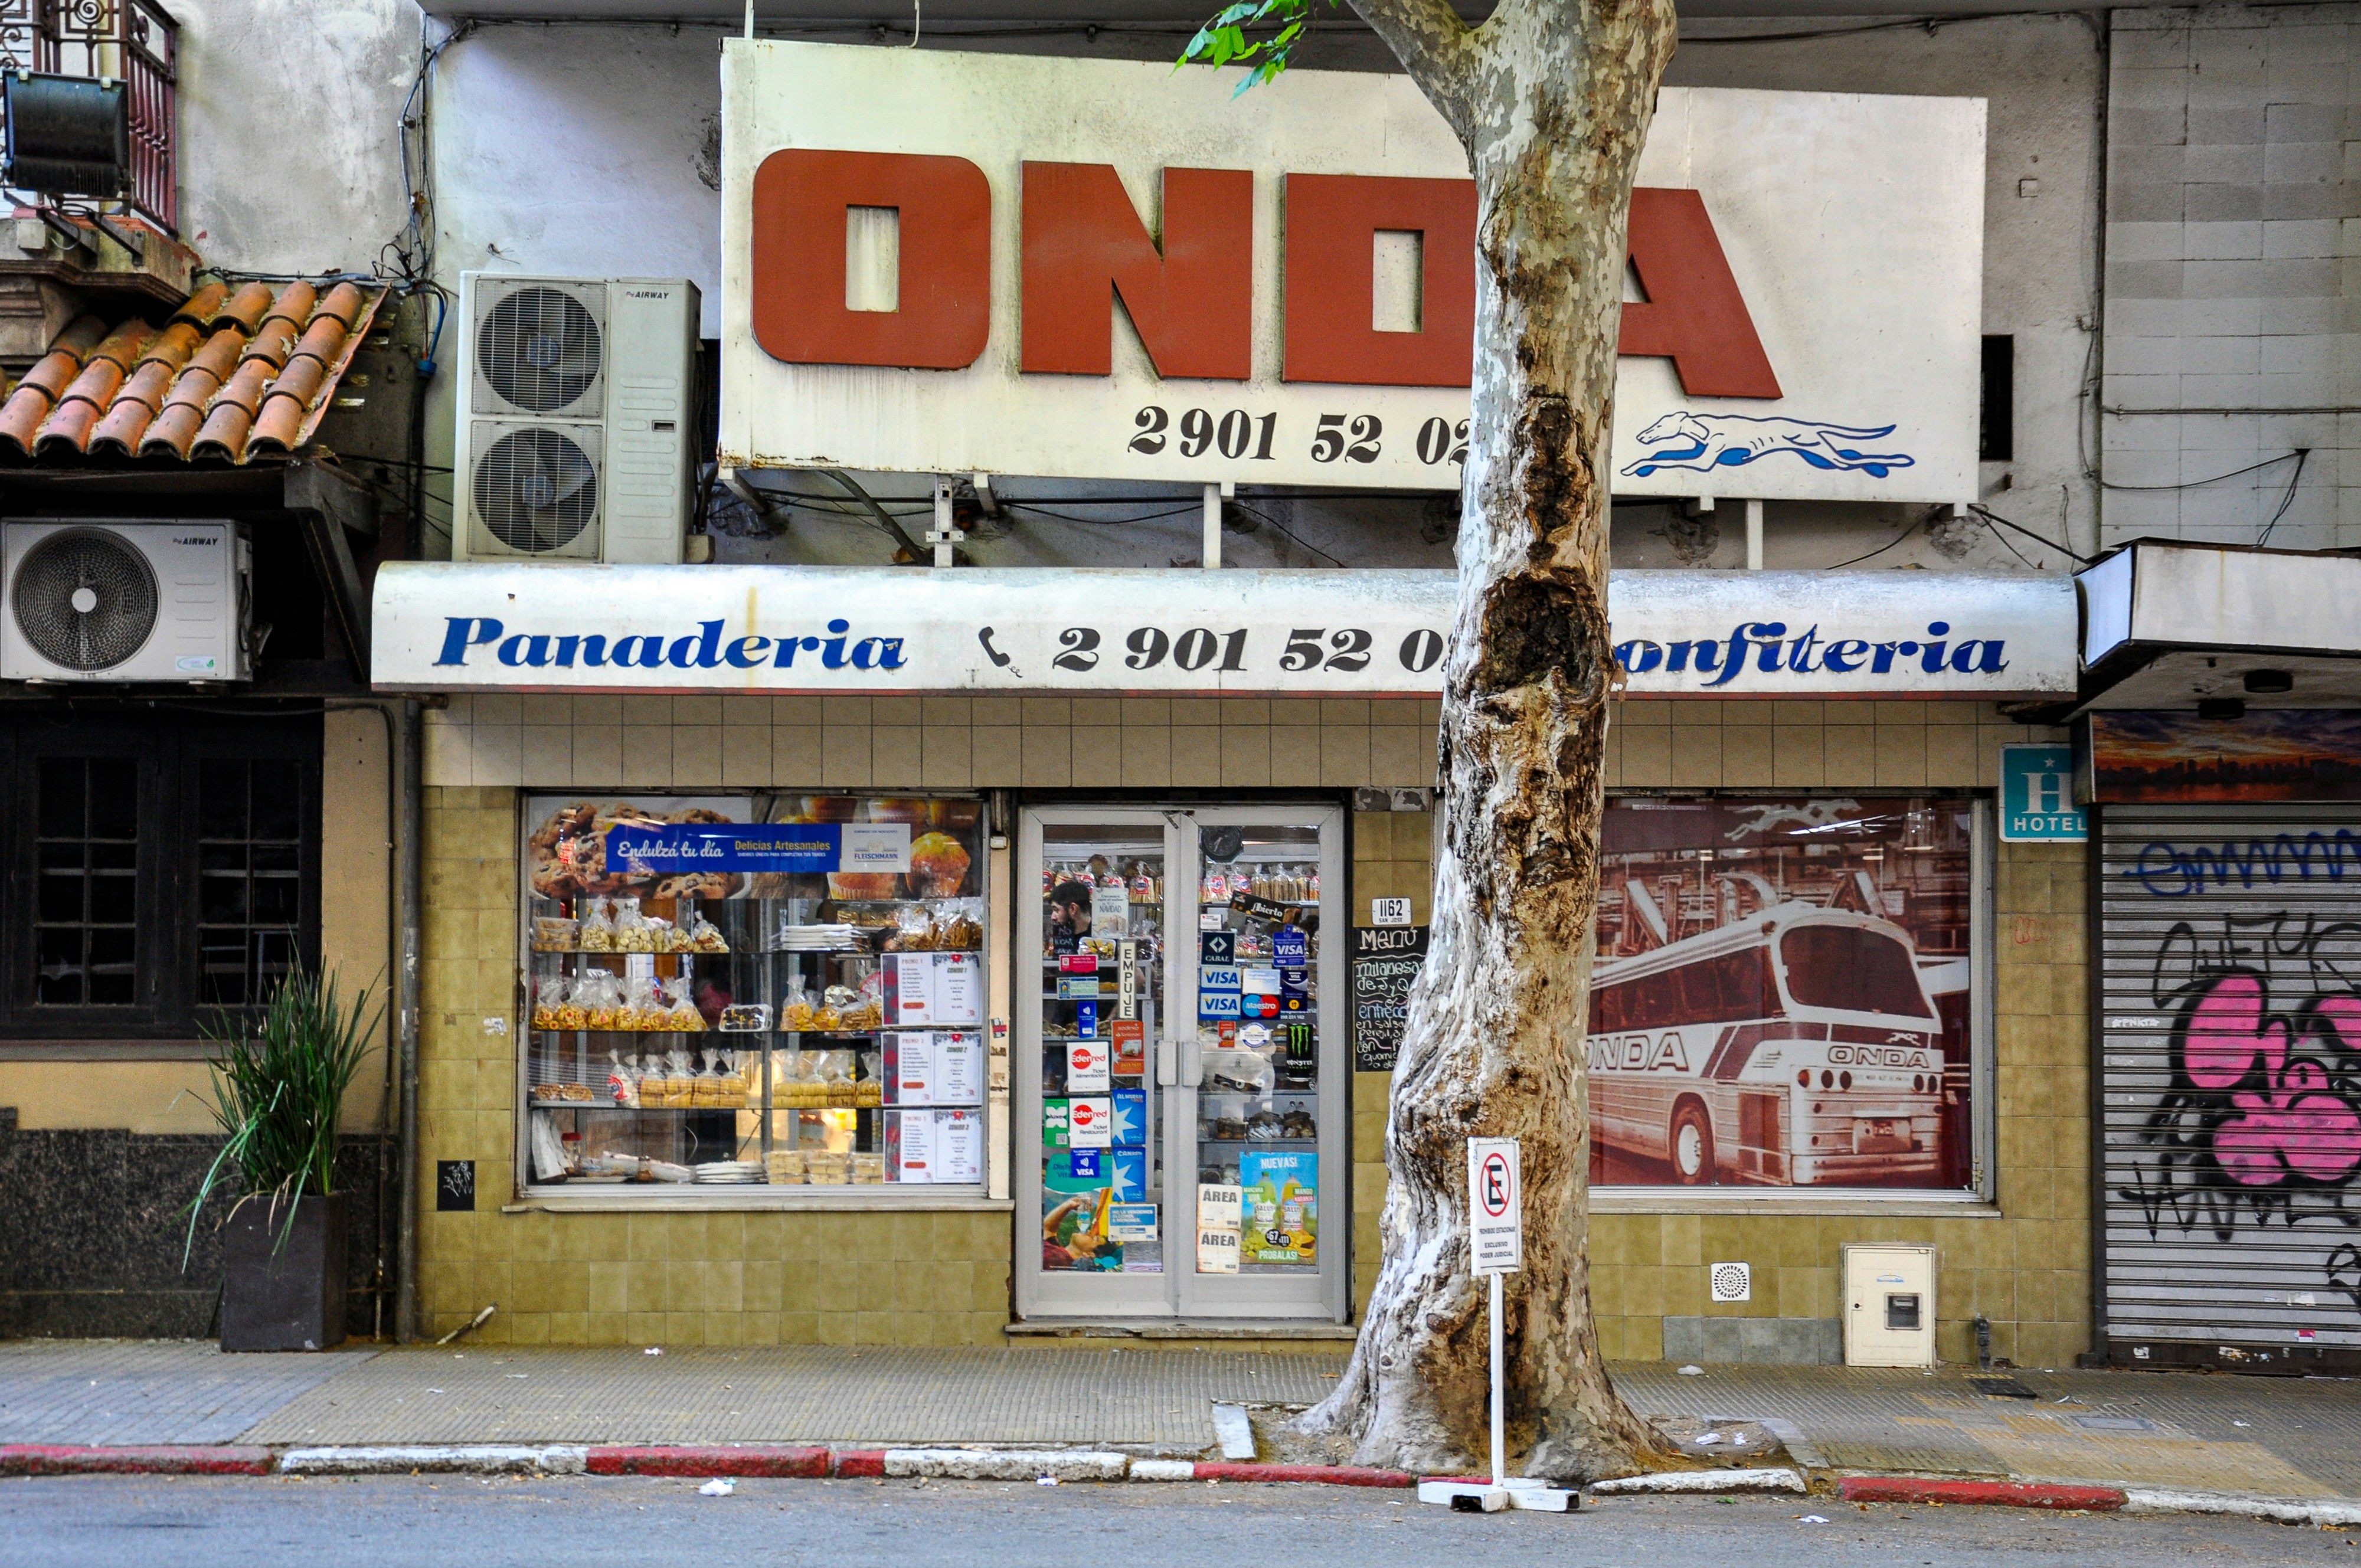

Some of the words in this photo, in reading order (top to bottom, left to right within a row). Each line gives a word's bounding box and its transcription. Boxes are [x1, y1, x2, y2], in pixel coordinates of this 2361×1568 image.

[751, 148, 1784, 400] ONDA
[635, 290, 670, 300] AIRWAY
[1311, 413, 1383, 464] 52
[181, 538, 218, 546] AIRWAY
[431, 616, 908, 670] Panaderia
[1052, 627, 1101, 672] 2
[1125, 627, 1249, 673] 901
[1278, 628, 1374, 673] 52
[1398, 628, 1453, 673] 0
[1609, 620, 2010, 688] onfiteria
[2020, 772, 2079, 814] H
[2013, 817, 2088, 832] HOTEL
[617, 839, 679, 857] Endulzá
[680, 840, 699, 857] tu
[699, 840, 725, 857] día
[734, 840, 772, 850] Delicias
[774, 840, 831, 850] Artesanales
[1251, 902, 1283, 918] Abierto
[1379, 899, 1403, 917] 1162
[1276, 945, 1304, 955] VISA
[1123, 948, 1133, 1017] EMPUJE
[1205, 971, 1238, 984] VISA
[1357, 976, 1376, 991] de
[1204, 998, 1238, 1011] VISA
[1071, 1054, 1107, 1063] Edenred
[1827, 1045, 1930, 1069] ONDA
[1073, 1110, 1107, 1119] Edenred
[1260, 1157, 1298, 1169] NUEVAS!
[1202, 1189, 1238, 1203] ÁREA
[1201, 1232, 1236, 1247] ÁREA
